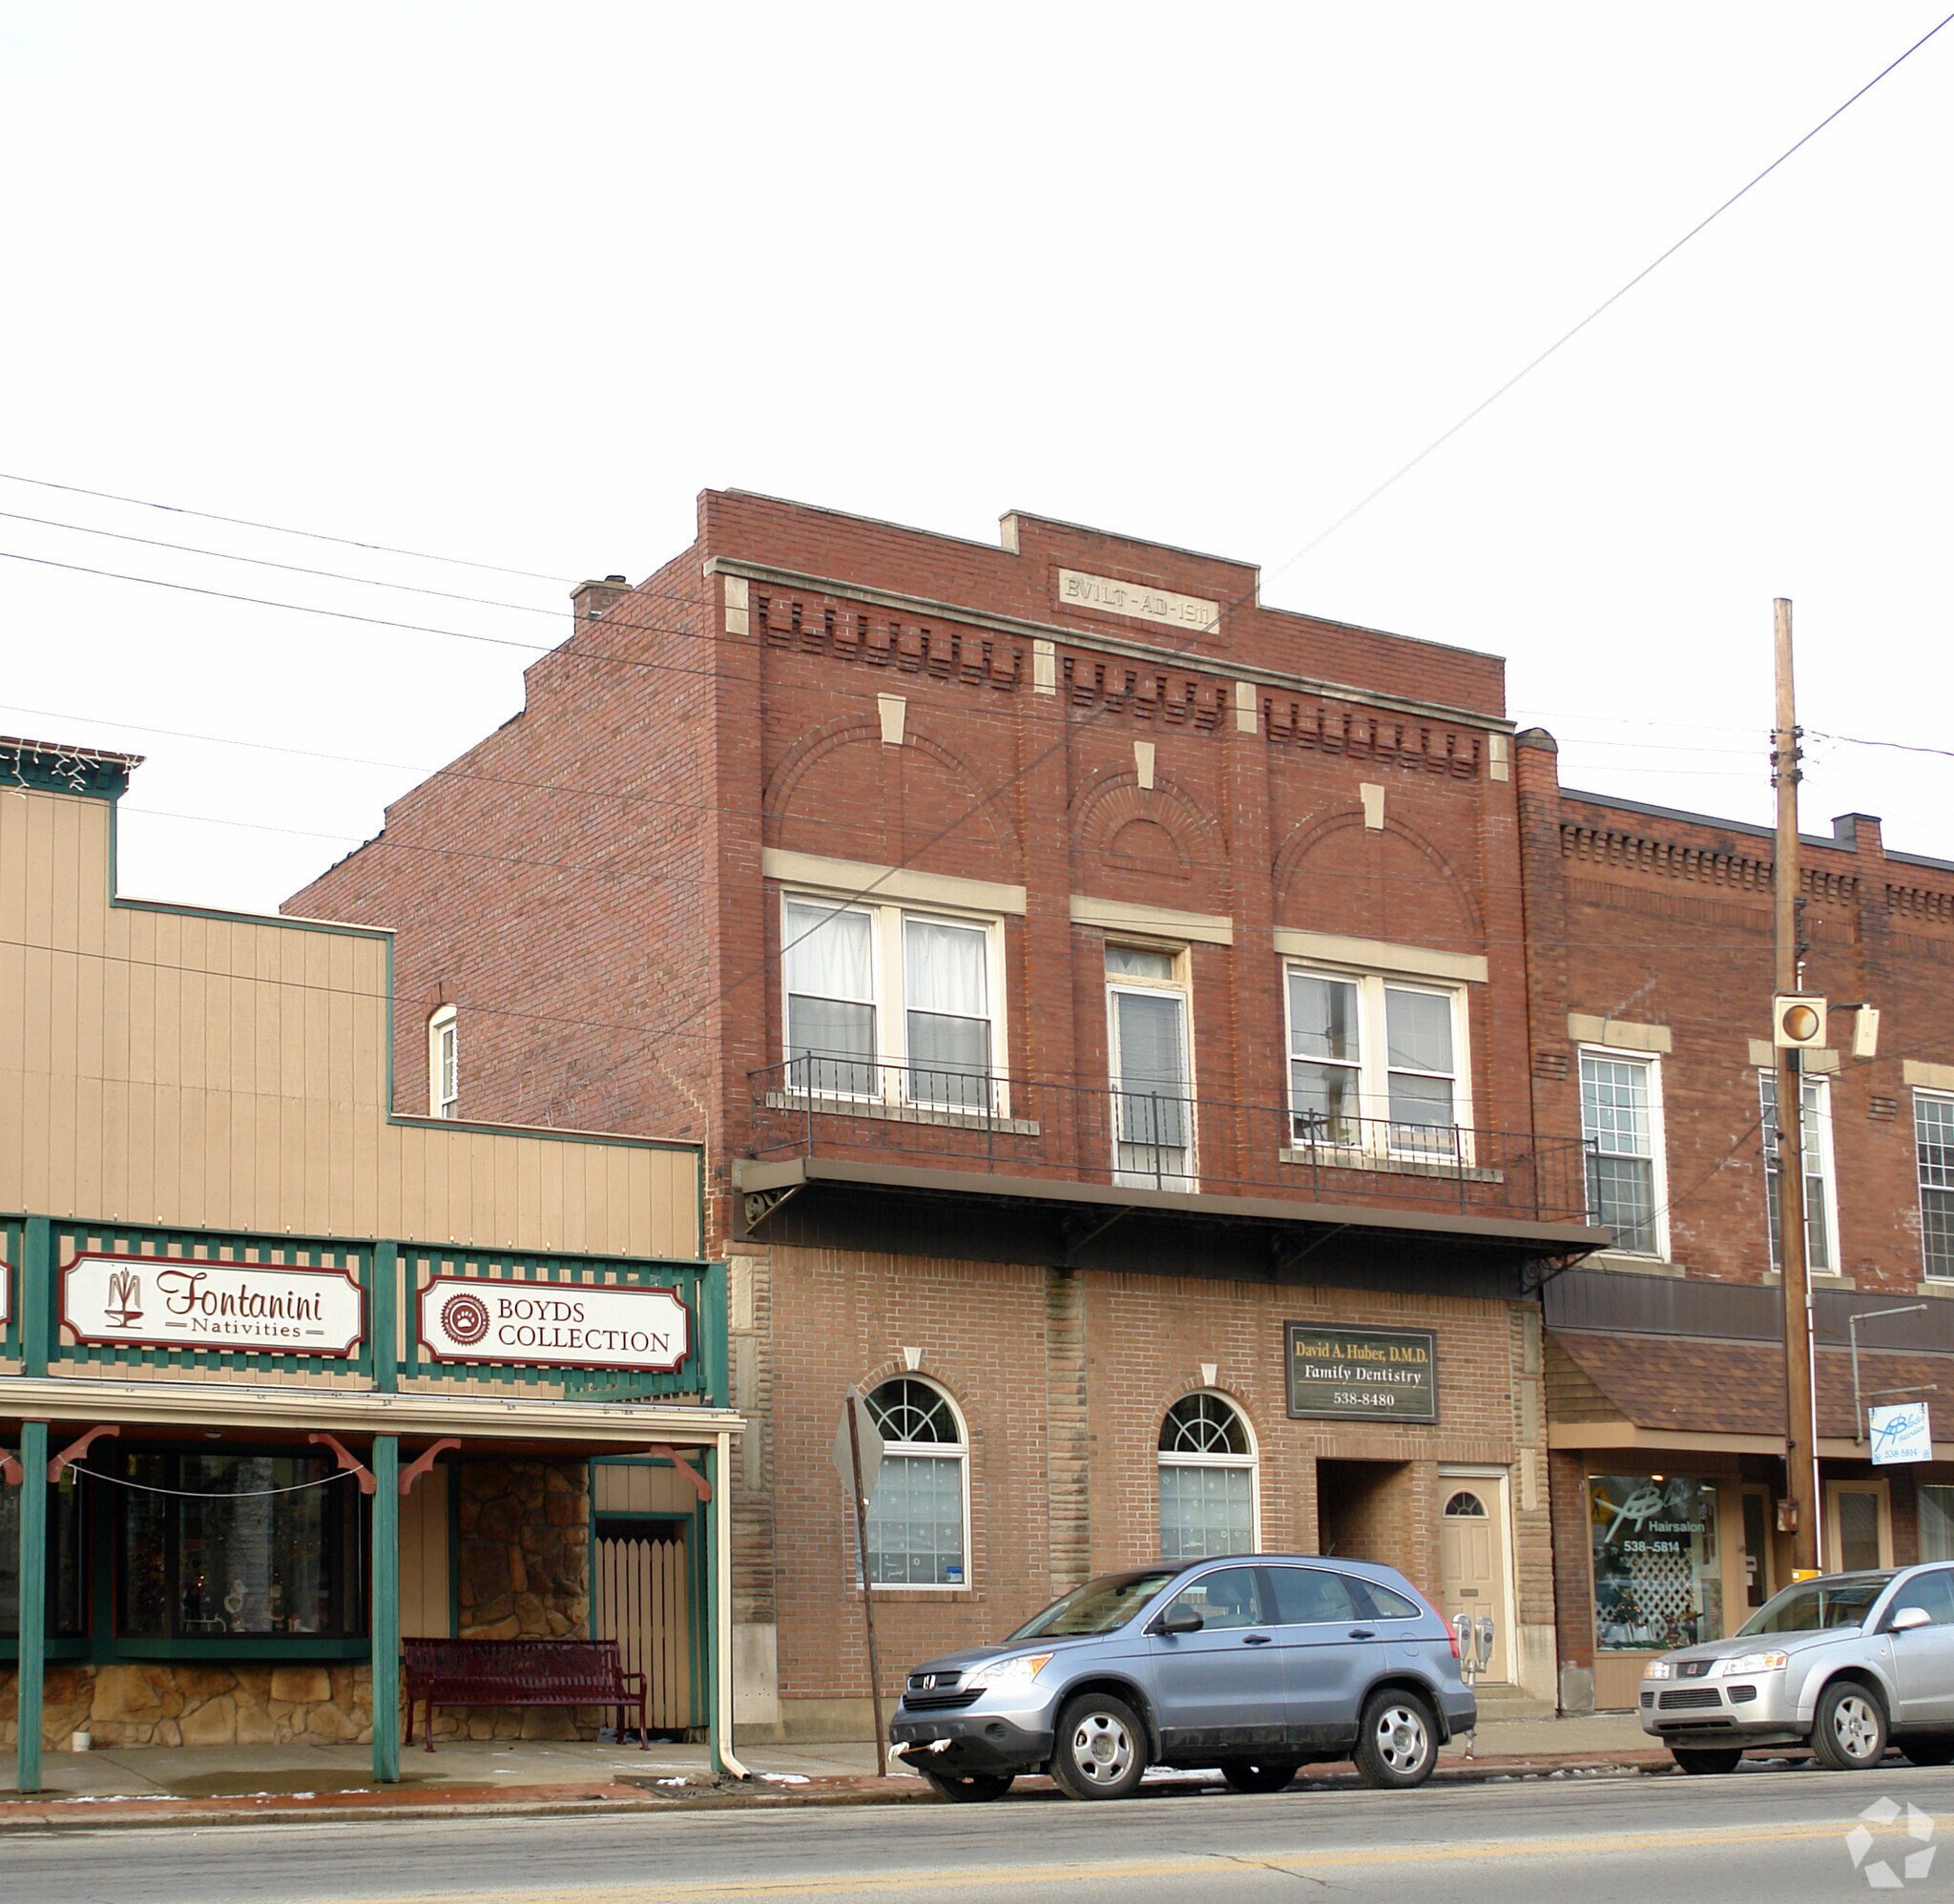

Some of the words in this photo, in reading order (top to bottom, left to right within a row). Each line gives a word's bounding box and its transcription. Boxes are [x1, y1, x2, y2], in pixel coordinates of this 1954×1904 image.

[156, 1270, 322, 1321] Fontanini
[497, 1298, 585, 1323] BOYDS
[192, 1317, 301, 1337] Nativities
[498, 1325, 671, 1353] COLLECTION
[1295, 1341, 1330, 1358] David
[1332, 1344, 1344, 1359] A.
[1346, 1344, 1385, 1364] Huber,
[1389, 1346, 1428, 1363] D.M.D.
[1305, 1364, 1352, 1385] Family
[1356, 1367, 1422, 1389] Dentistry
[1333, 1392, 1395, 1407] 538-8480
[1648, 1520, 1706, 1533] Hairsalon
[1624, 1540, 1679, 1553] 538-5814
